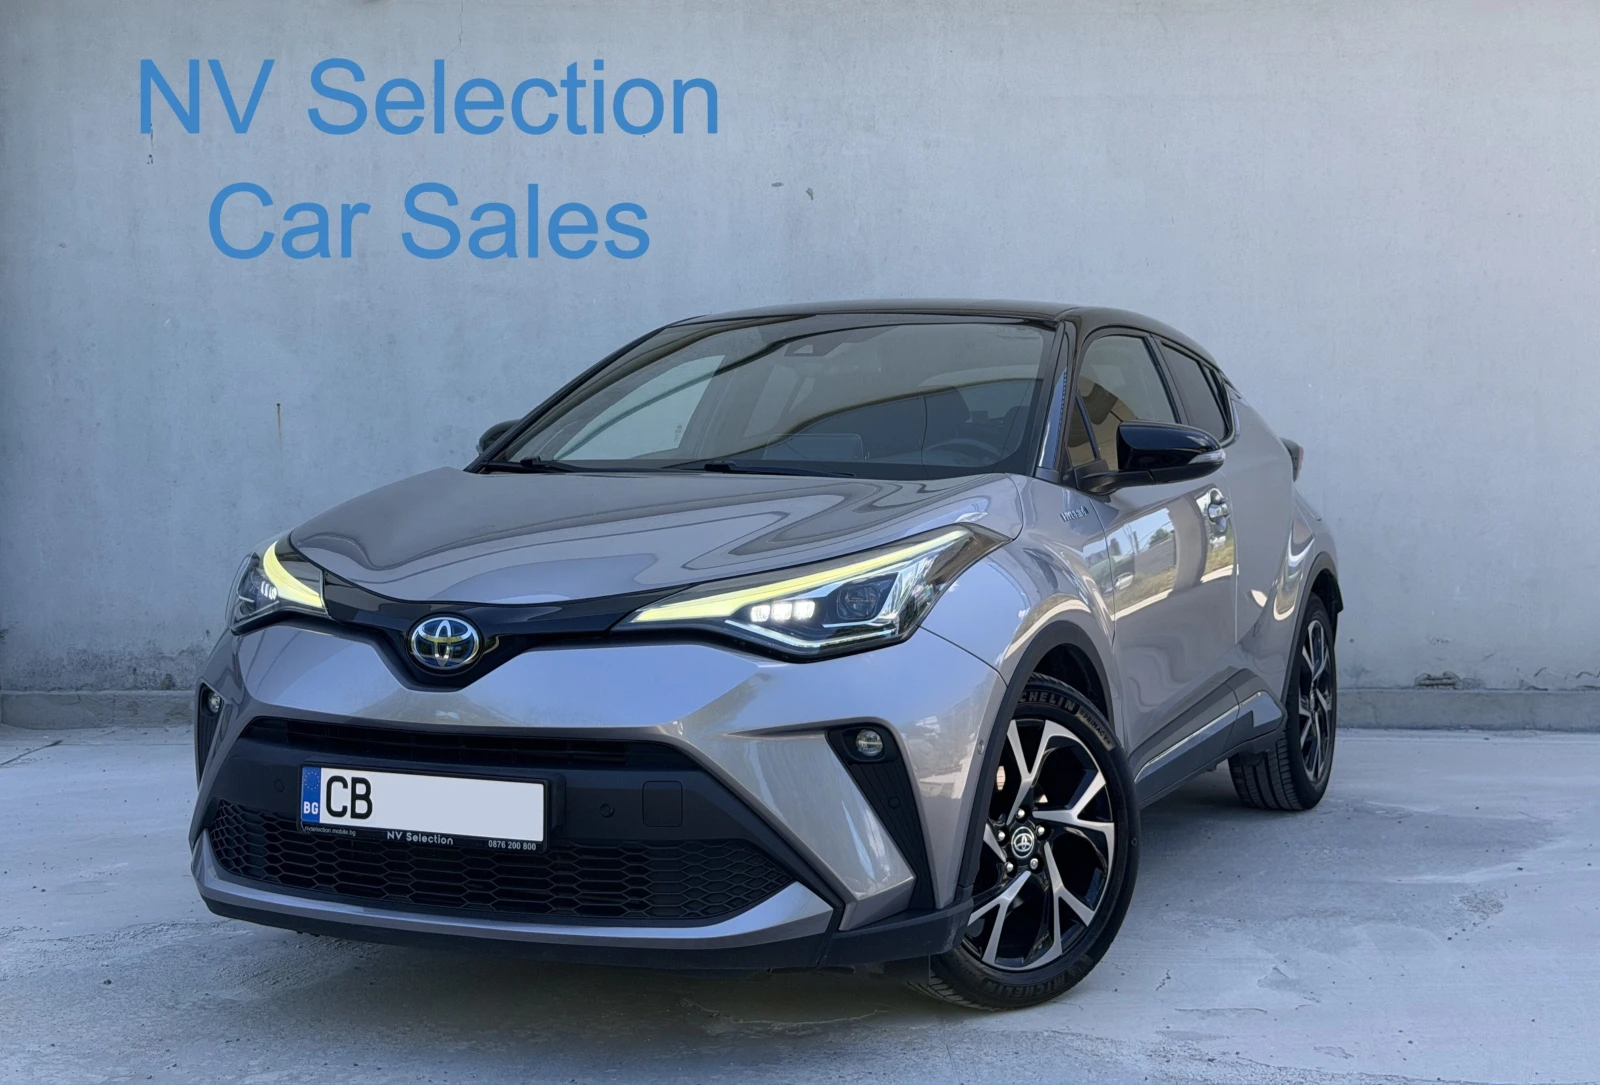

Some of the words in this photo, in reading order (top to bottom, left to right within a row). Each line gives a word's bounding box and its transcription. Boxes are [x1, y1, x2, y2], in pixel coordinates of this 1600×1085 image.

[1018, 690, 1076, 712] CHELIN
[1082, 713, 1108, 741] PRIMACY
[326, 775, 373, 820] CB
[303, 801, 319, 815] BG
[386, 830, 403, 841] NV
[406, 832, 454, 846] Selection
[488, 839, 506, 849] 0876
[507, 841, 521, 850] 200
[522, 842, 537, 851] 800
